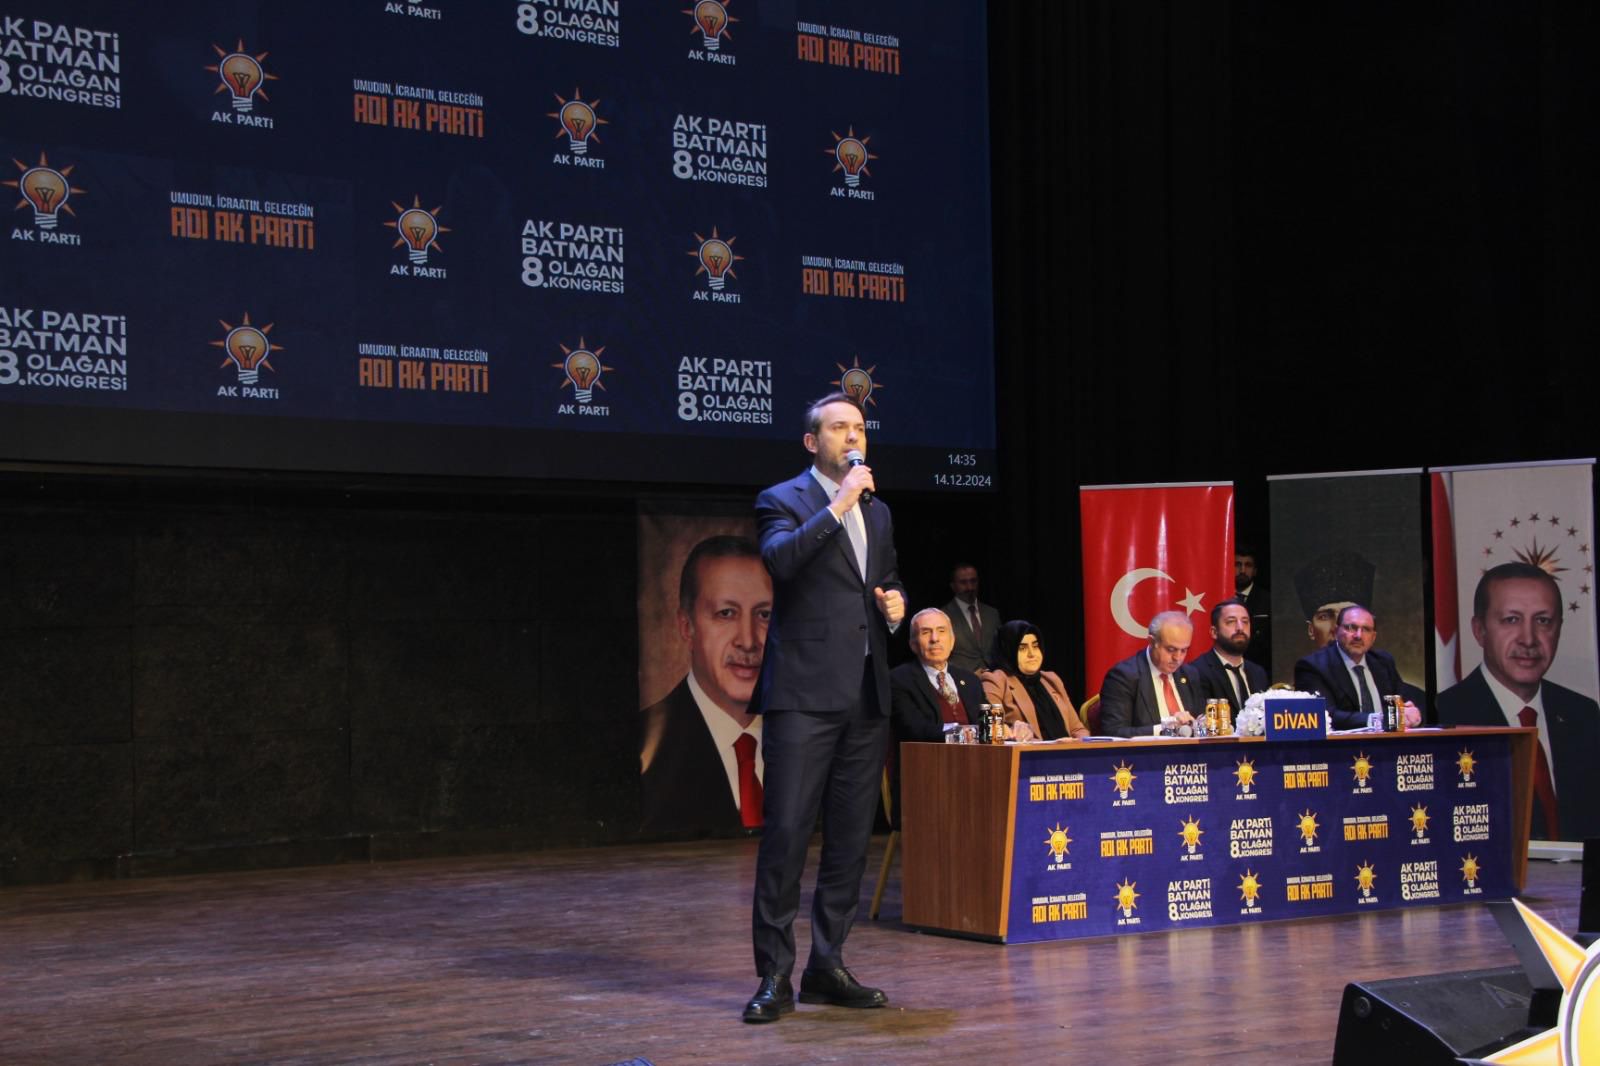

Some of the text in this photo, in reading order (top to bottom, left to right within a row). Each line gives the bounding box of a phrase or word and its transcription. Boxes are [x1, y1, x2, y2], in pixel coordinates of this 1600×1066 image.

[385, 2, 404, 14] AK
[0, 17, 24, 38] K
[545, 10, 618, 33] OLAĞAN
[0, 40, 119, 73] ATMAN
[688, 50, 704, 60] AK
[798, 34, 824, 63] ADI
[828, 39, 850, 66] AK
[20, 64, 120, 92] OLAĞAN
[212, 112, 232, 123] AK
[354, 94, 387, 126] ADI
[393, 99, 420, 129] AK
[674, 114, 702, 133] AK
[674, 132, 766, 158] BATMAN
[554, 154, 570, 164] AK
[698, 154, 766, 174] OLAĞAN
[831, 187, 845, 196] AK
[171, 207, 208, 239] ADI
[214, 212, 244, 242] AK
[522, 220, 554, 238] AK
[12, 229, 34, 240] AK
[522, 238, 623, 262] BATMAN
[390, 265, 408, 275] AK
[549, 260, 623, 280] OLAĞAN
[803, 268, 829, 295] ADI
[834, 272, 855, 297] AK
[693, 291, 708, 300] AK
[28, 354, 126, 375] OLAĞAN
[678, 356, 708, 373] AK
[360, 358, 392, 388] ADI
[399, 360, 425, 389] AK
[218, 386, 238, 396] AK
[678, 374, 771, 394] BATMAN
[558, 404, 575, 414] AK
[703, 395, 772, 411] OLAĞAN
[948, 454, 976, 466] 14:35
[934, 474, 991, 486] 14.12.2024
[1274, 709, 1318, 730] DİVAN
[1397, 756, 1409, 766] AK
[1165, 765, 1178, 776] AK
[1397, 764, 1433, 776] BATMAN
[1165, 774, 1207, 785] BATMAN
[1296, 772, 1307, 788] AK
[1046, 784, 1058, 800] AK
[1454, 806, 1464, 816] AK
[1231, 820, 1245, 831] AK
[1454, 814, 1488, 826] BATMAN
[1230, 828, 1272, 840] BATMAN
[1356, 824, 1368, 840] AK
[1116, 839, 1128, 856] AK
[1401, 863, 1413, 874] AK
[1401, 872, 1437, 883] BATMAN
[1168, 881, 1181, 892] AK
[1300, 884, 1310, 900] AK
[1168, 890, 1210, 902] BATMAN
[1048, 904, 1060, 922] AK
